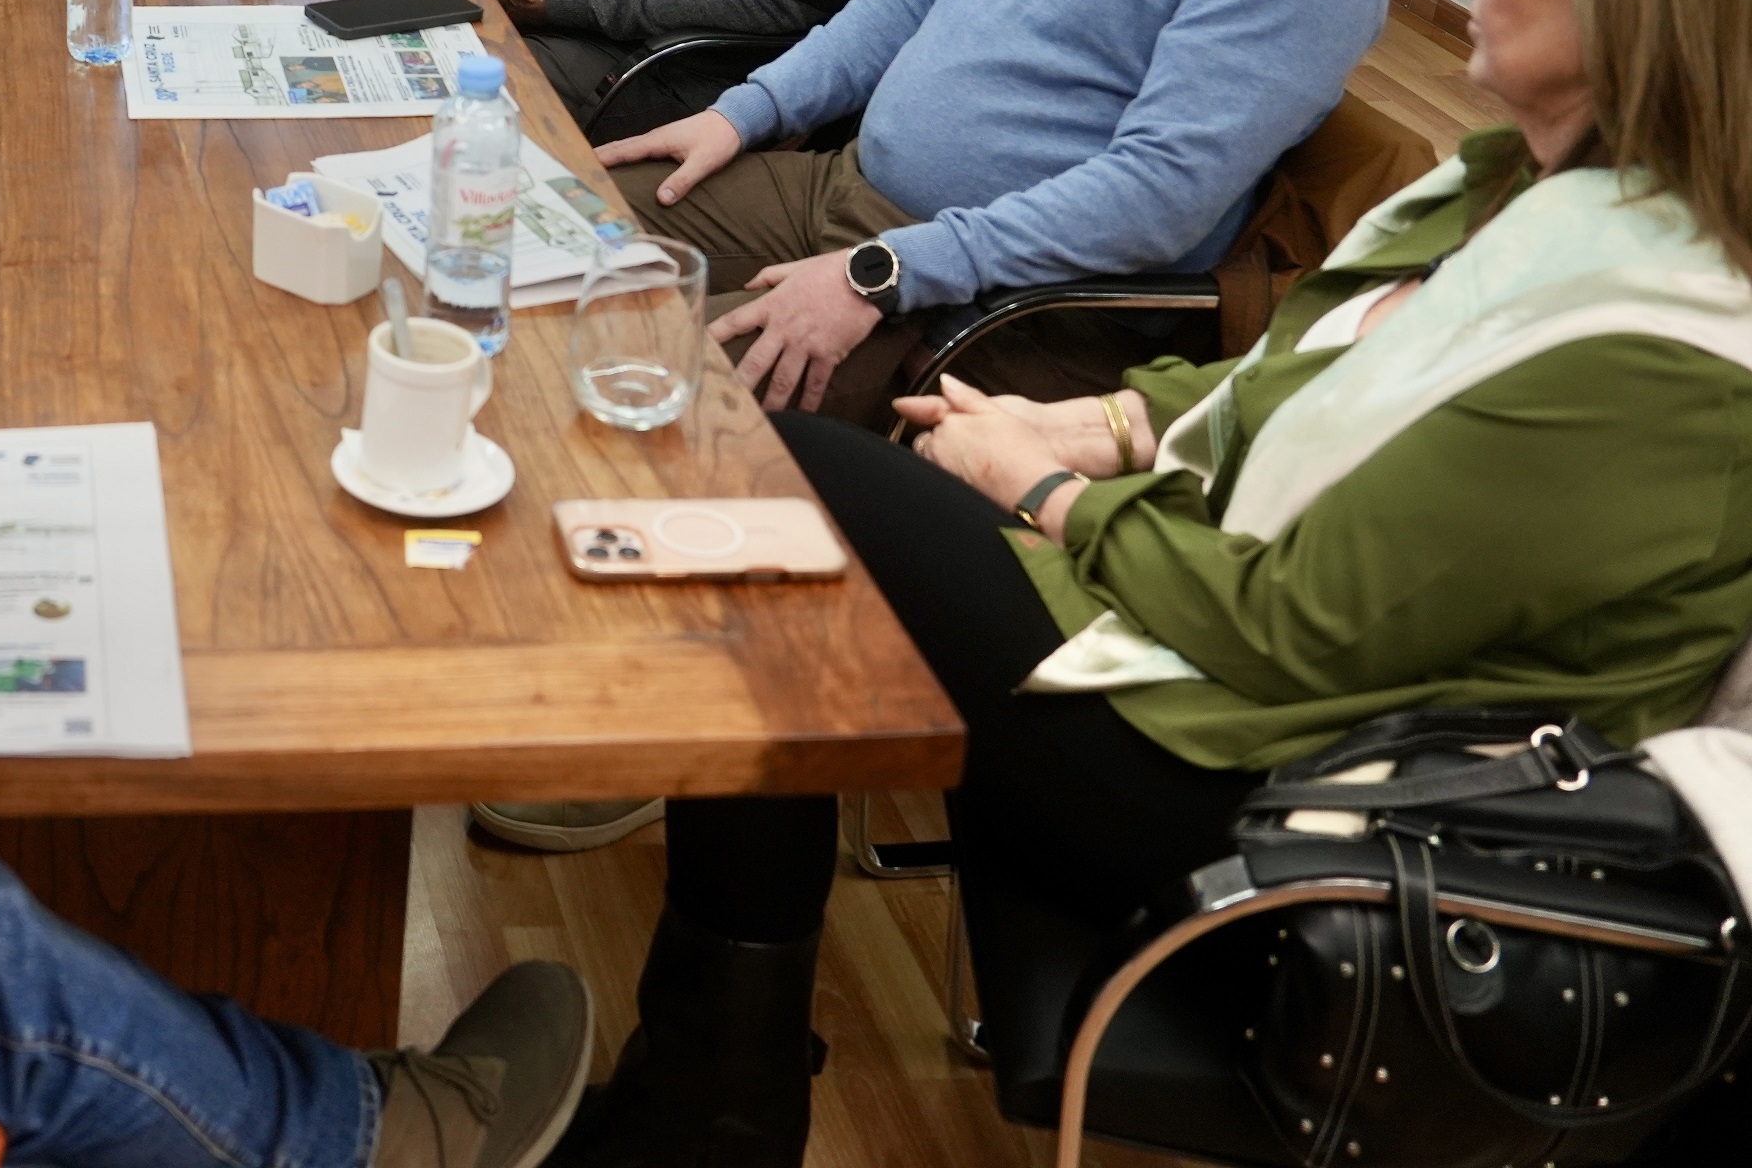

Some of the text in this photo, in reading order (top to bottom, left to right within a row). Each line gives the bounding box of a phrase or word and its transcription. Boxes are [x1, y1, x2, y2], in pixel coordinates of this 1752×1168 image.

[144, 43, 157, 61] CRUZ
[161, 52, 175, 73] PUEDE
[147, 62, 161, 83] SANTA
